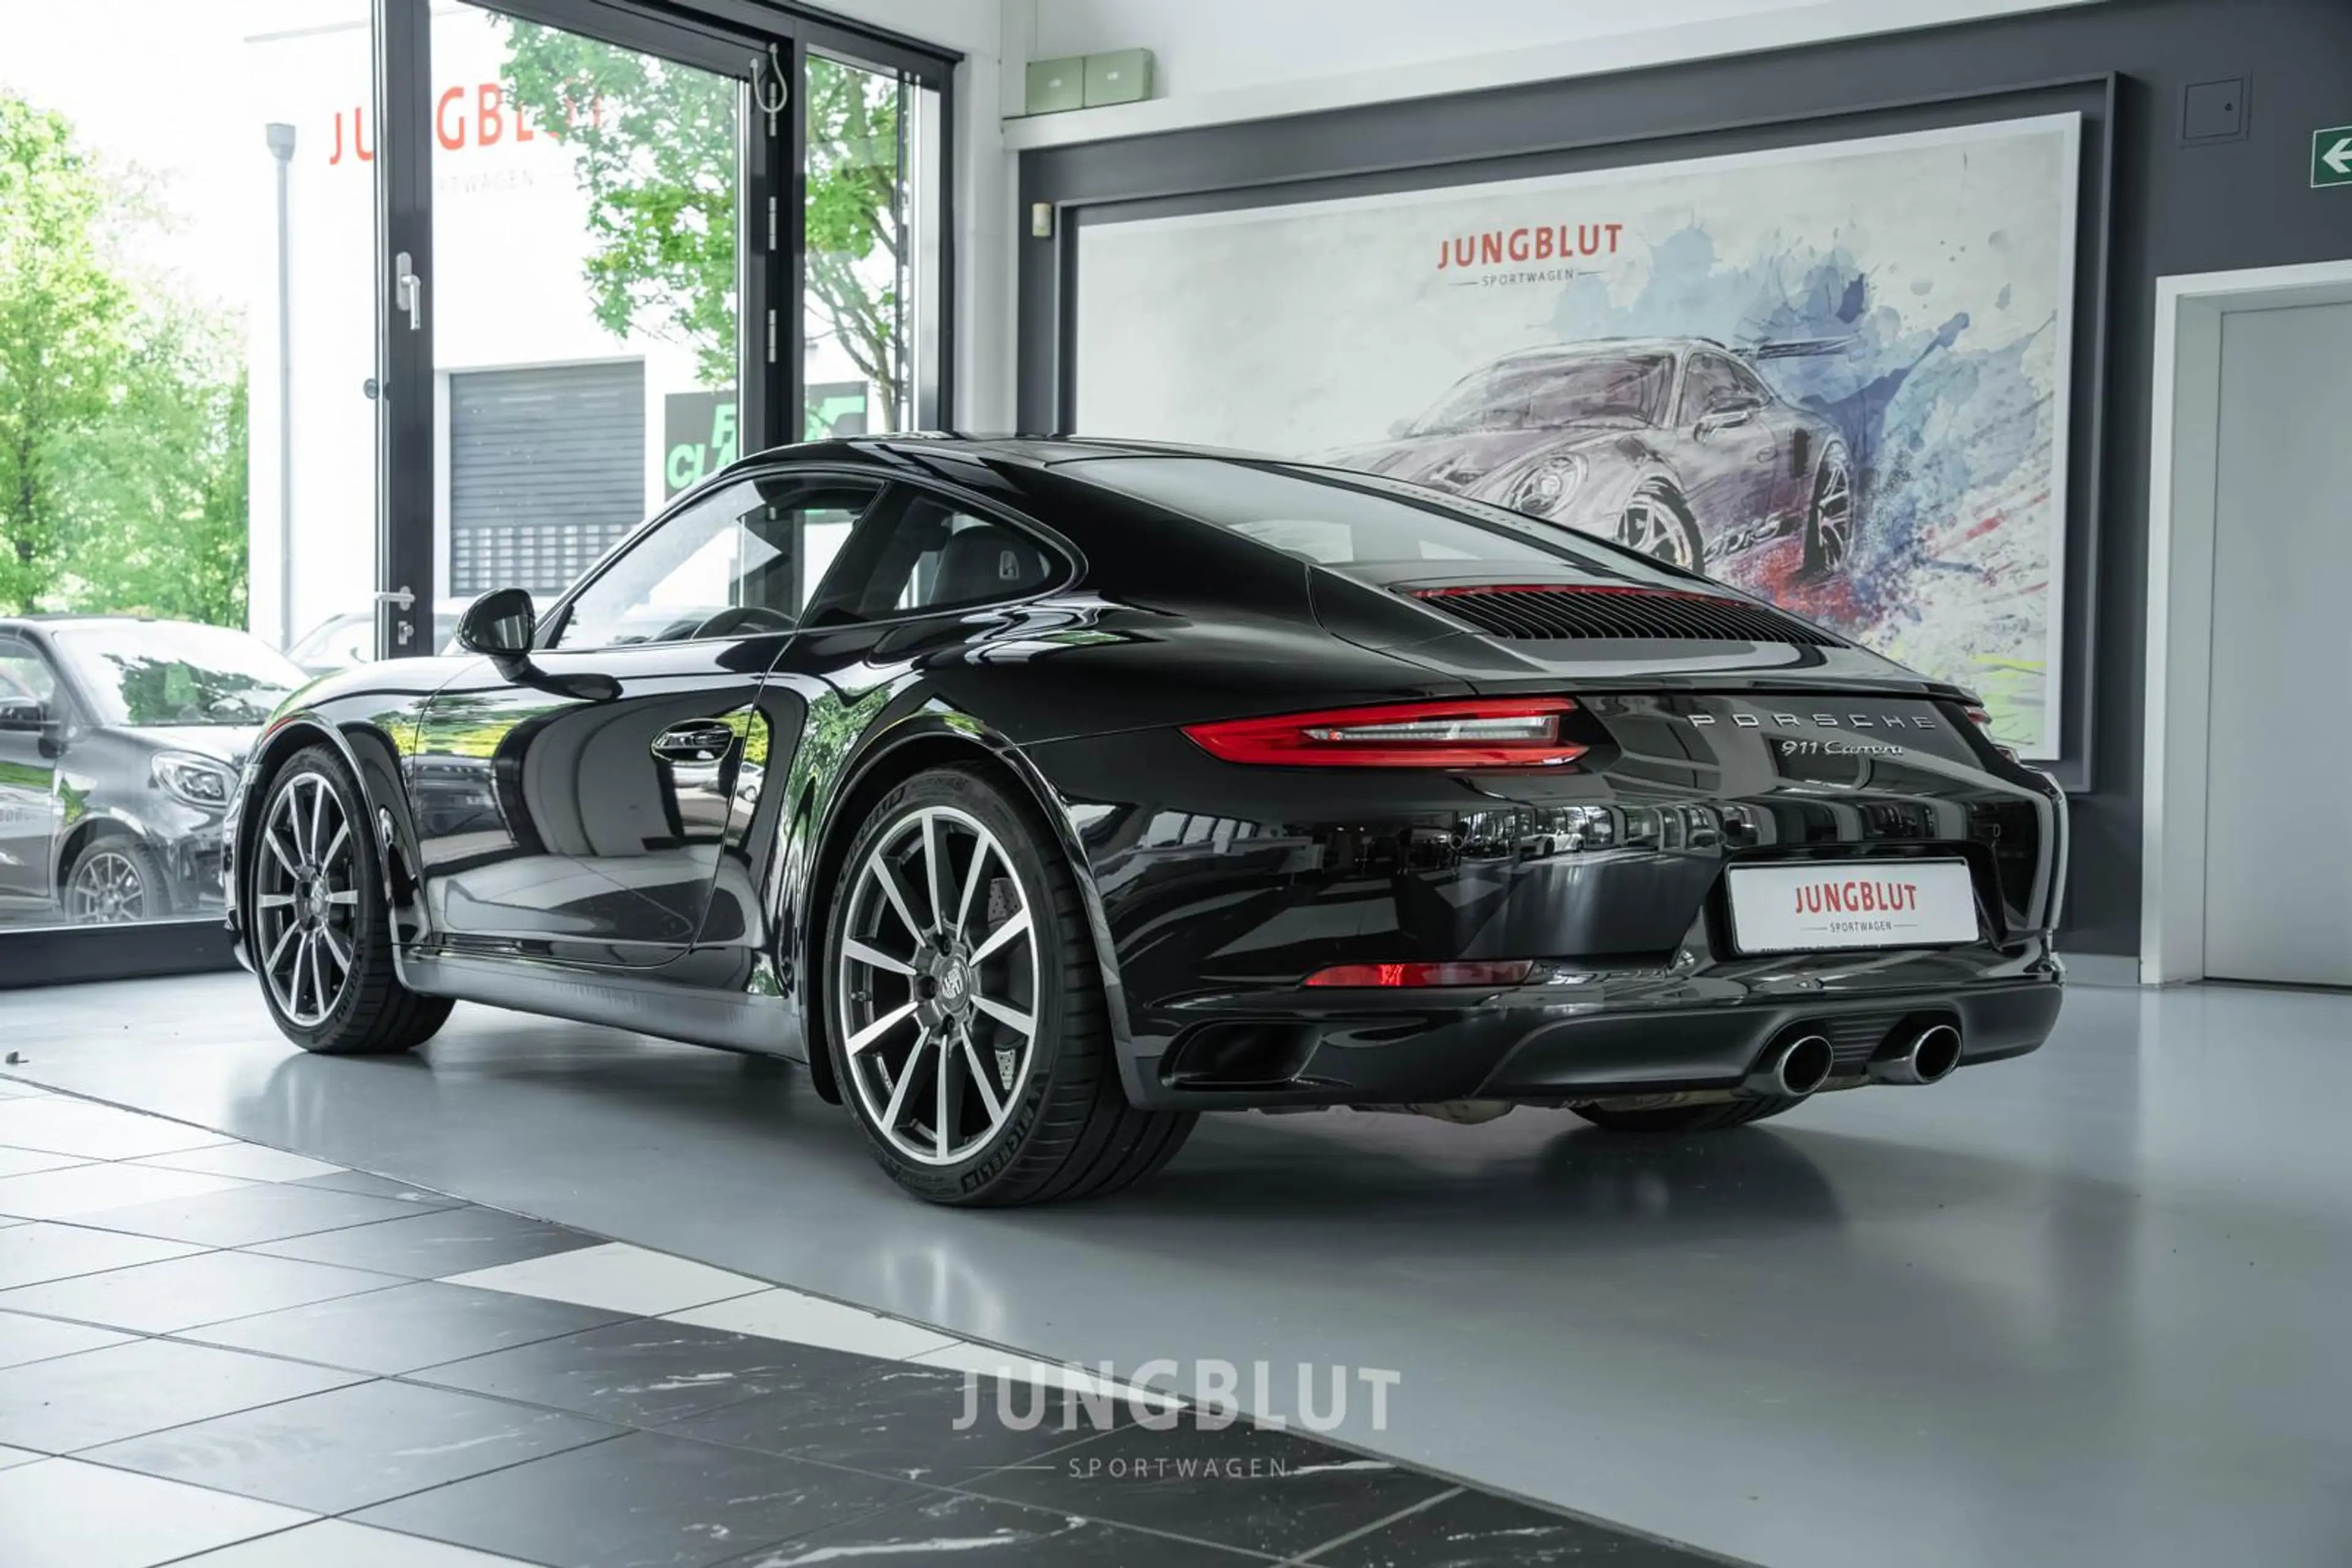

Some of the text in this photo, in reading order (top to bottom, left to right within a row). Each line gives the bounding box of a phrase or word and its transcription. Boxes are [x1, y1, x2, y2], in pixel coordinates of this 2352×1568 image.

[1437, 224, 1623, 269] JUNGBLUT
[1482, 269, 1575, 287] SPORTWAGEN
[1687, 714, 1936, 729] PORSCHE
[1781, 740, 1905, 756] 911 Carrera
[1795, 881, 1917, 913] JUNGBLUT
[1830, 921, 1892, 933] SPORTWAGEN
